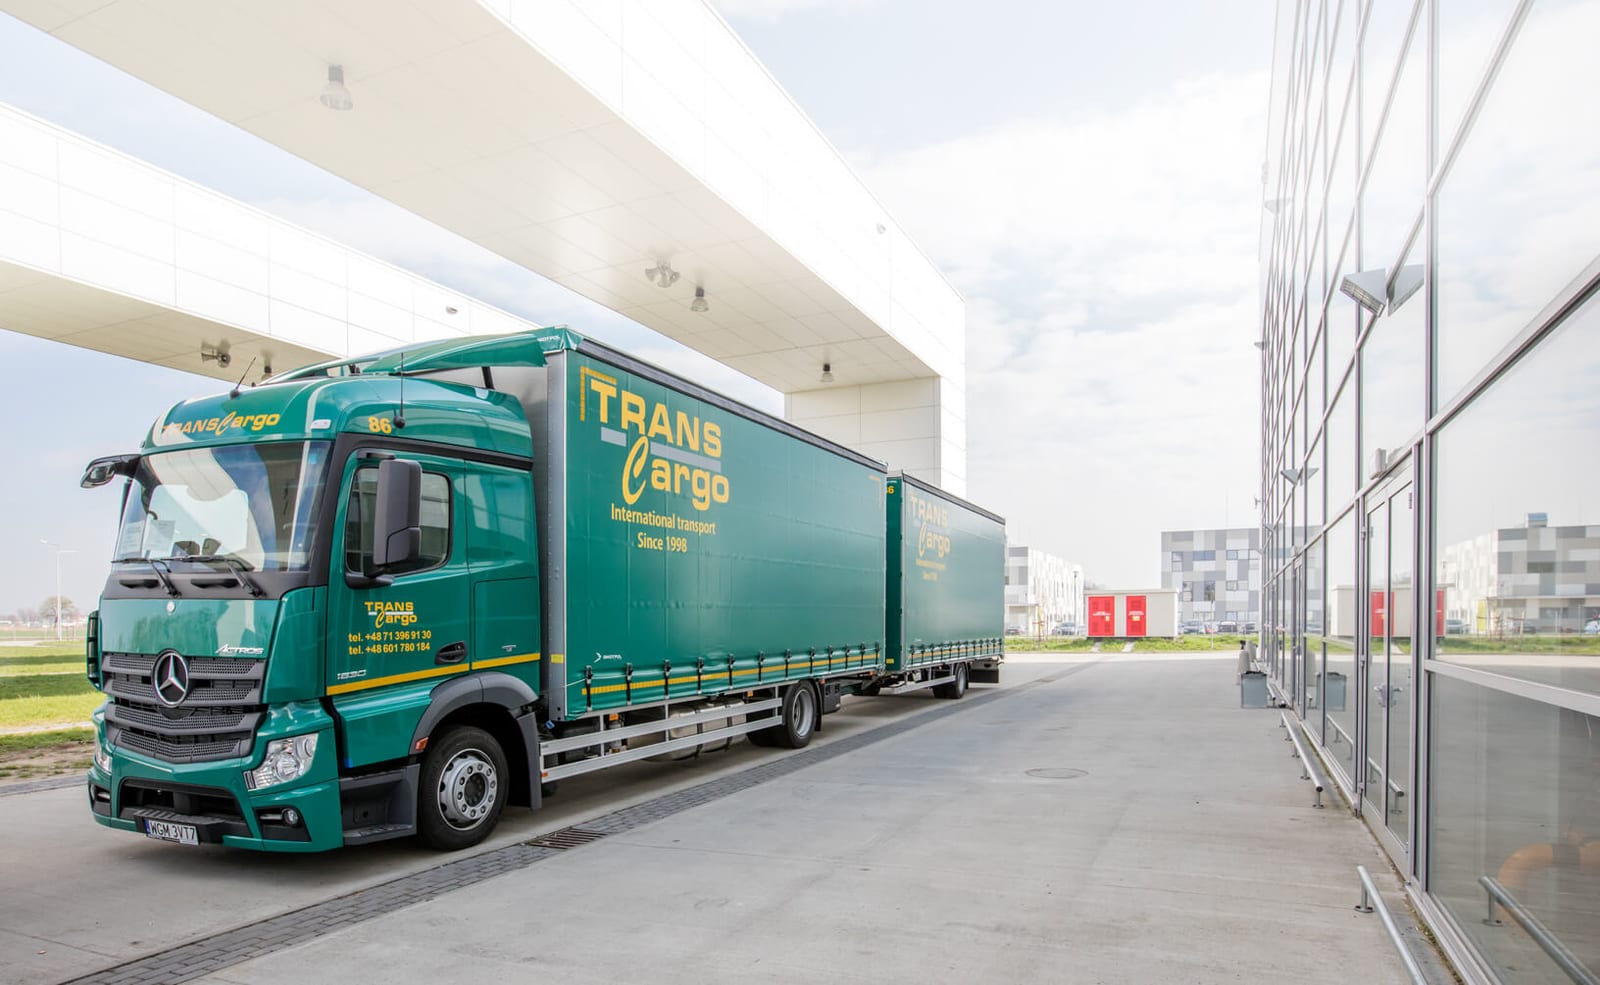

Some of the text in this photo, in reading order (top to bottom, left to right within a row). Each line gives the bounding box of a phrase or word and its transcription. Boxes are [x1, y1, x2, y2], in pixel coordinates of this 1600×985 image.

[368, 415, 392, 434] 86
[590, 378, 722, 458] TRANS
[622, 435, 730, 511] Cargo
[611, 503, 716, 536] International transport
[637, 532, 688, 553] Since 1998
[364, 602, 414, 611] TRANS
[375, 609, 417, 628] Cargo
[348, 630, 431, 642] tel. +48 71 396 91 30
[348, 642, 430, 655] tel. +48 601 780 184
[151, 821, 170, 836] WGM
[171, 825, 195, 840] 3VT7
